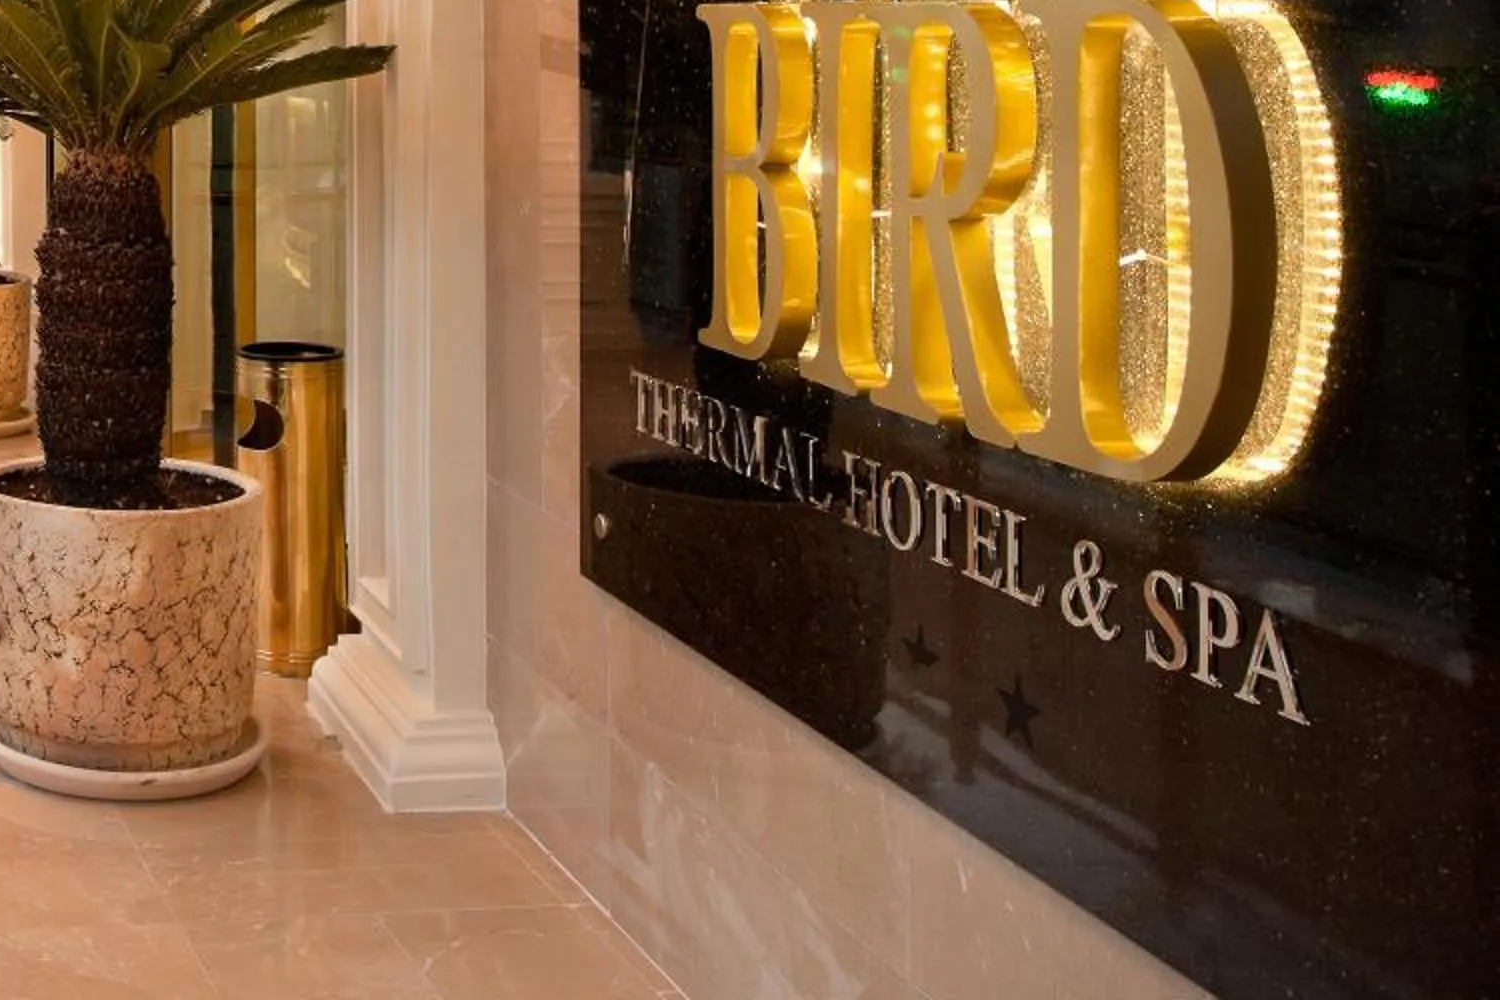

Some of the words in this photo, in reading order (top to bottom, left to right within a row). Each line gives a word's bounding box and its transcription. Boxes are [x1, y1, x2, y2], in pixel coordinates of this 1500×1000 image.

[629, 369, 833, 513] THERMAL
[841, 450, 1046, 608] HOTEL
[1061, 539, 1121, 642] &
[1143, 569, 1311, 727] SPA
